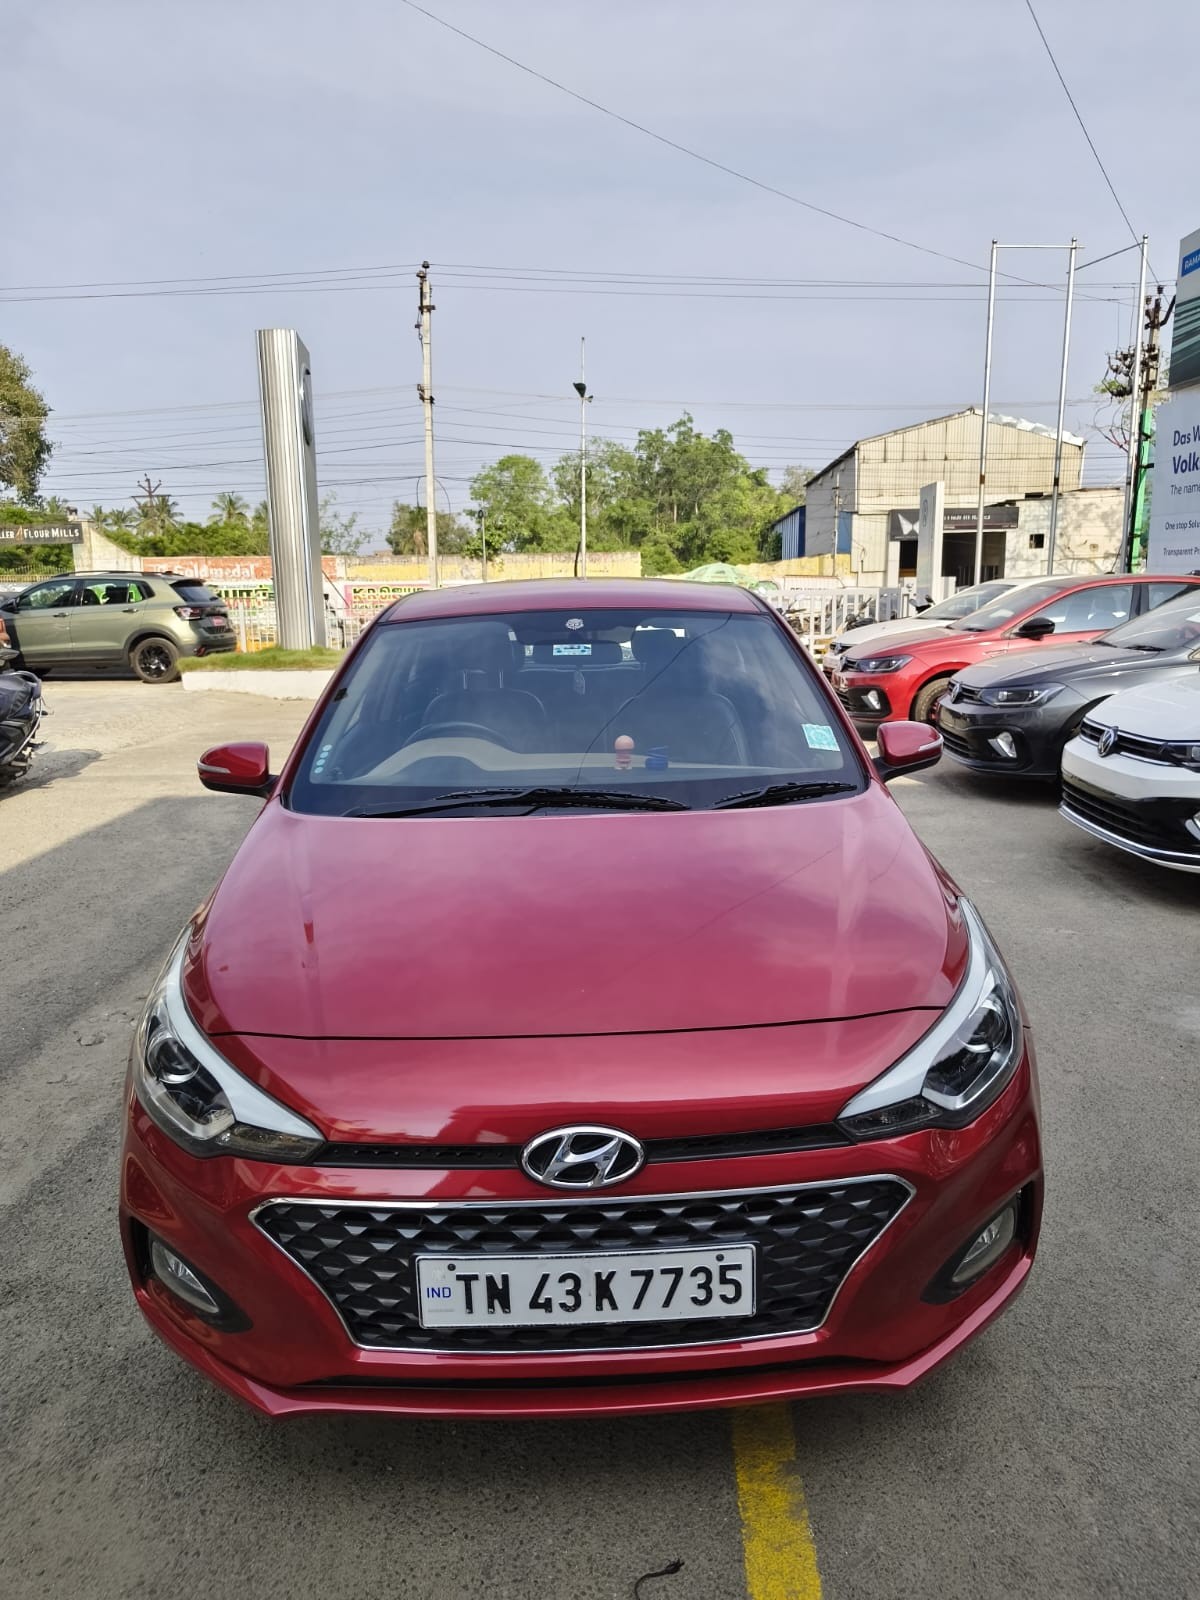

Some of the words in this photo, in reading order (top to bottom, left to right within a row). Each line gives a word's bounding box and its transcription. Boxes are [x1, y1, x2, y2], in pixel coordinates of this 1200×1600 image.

[1173, 430, 1191, 447] Das
[1172, 452, 1200, 475] Volk
[1170, 484, 1182, 496] The
[1165, 521, 1175, 530] One
[1176, 519, 1187, 530] stop
[23, 528, 50, 539] FLOUR
[51, 527, 80, 538] MILLS
[1163, 546, 1193, 558] Transparent
[426, 1286, 452, 1299] IND
[455, 1273, 511, 1315] TN
[528, 1271, 582, 1314] 43
[594, 1270, 619, 1312] K
[630, 1263, 743, 1311] 7735
